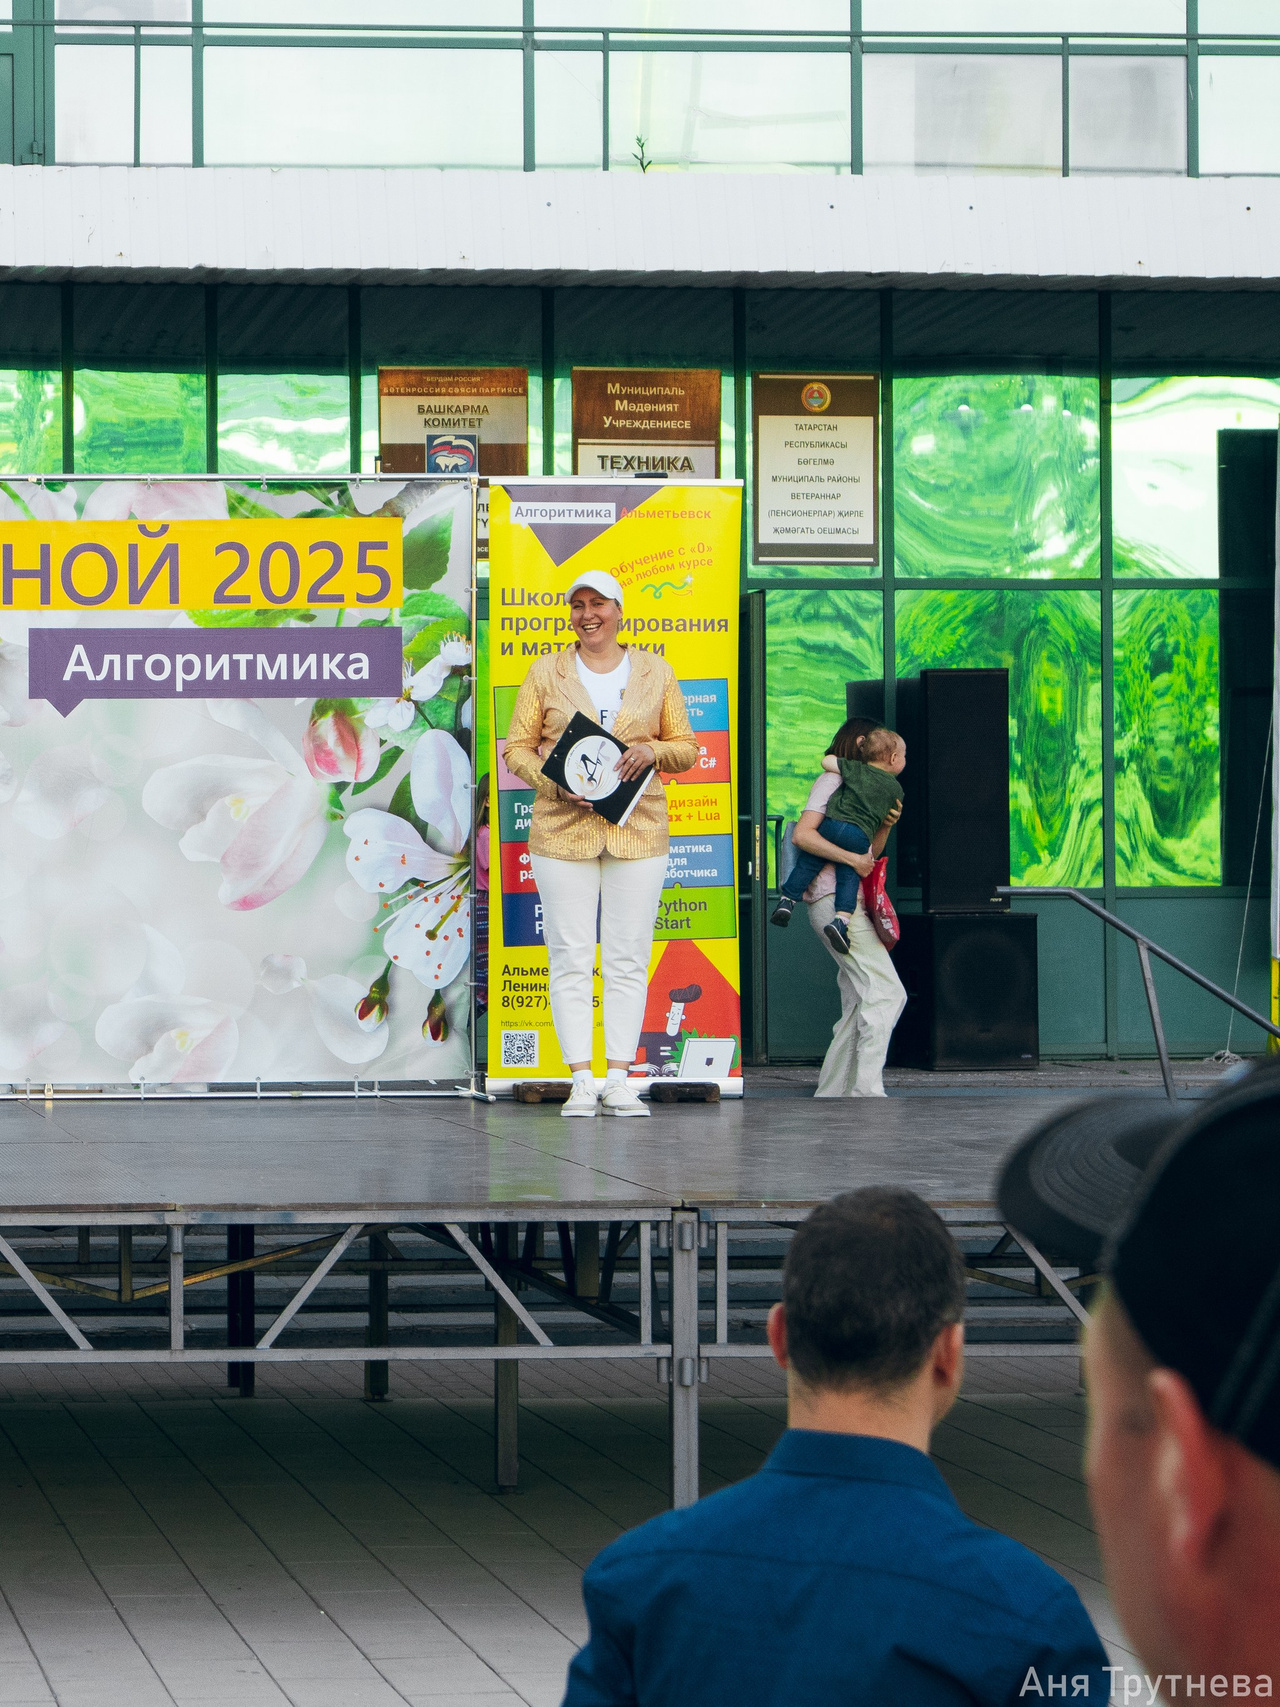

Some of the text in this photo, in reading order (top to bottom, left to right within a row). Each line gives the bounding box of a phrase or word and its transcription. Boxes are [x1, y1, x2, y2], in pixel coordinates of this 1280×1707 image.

[417, 404, 490, 415] БАШКАРМА
[423, 418, 483, 428] КОМИТЕТ
[597, 455, 694, 472] ТЕХНИКА
[797, 458, 835, 466] БӨГЕЛМӘ
[771, 474, 861, 483] МУНИЦИПАЛЬ РАЙОНЫ
[515, 506, 712, 521] Алгоритмика Альметьевск
[768, 510, 836, 518] (ПЕНСИОНЕРЛАР)
[817, 527, 859, 535] ОЕШМАСЫ
[609, 549, 675, 579] Обучение
[677, 547, 686, 556] с
[213, 540, 392, 604] 2025
[620, 557, 714, 590] на любом курсе
[501, 588, 567, 606] Школ
[501, 617, 729, 636] програирования
[501, 642, 513, 655] и
[62, 644, 369, 692] Алгоритмика
[697, 811, 720, 821] Lua
[669, 844, 713, 854] матика
[665, 868, 718, 879] аботчика
[654, 916, 691, 930] Start
[501, 980, 550, 992] Ленин
